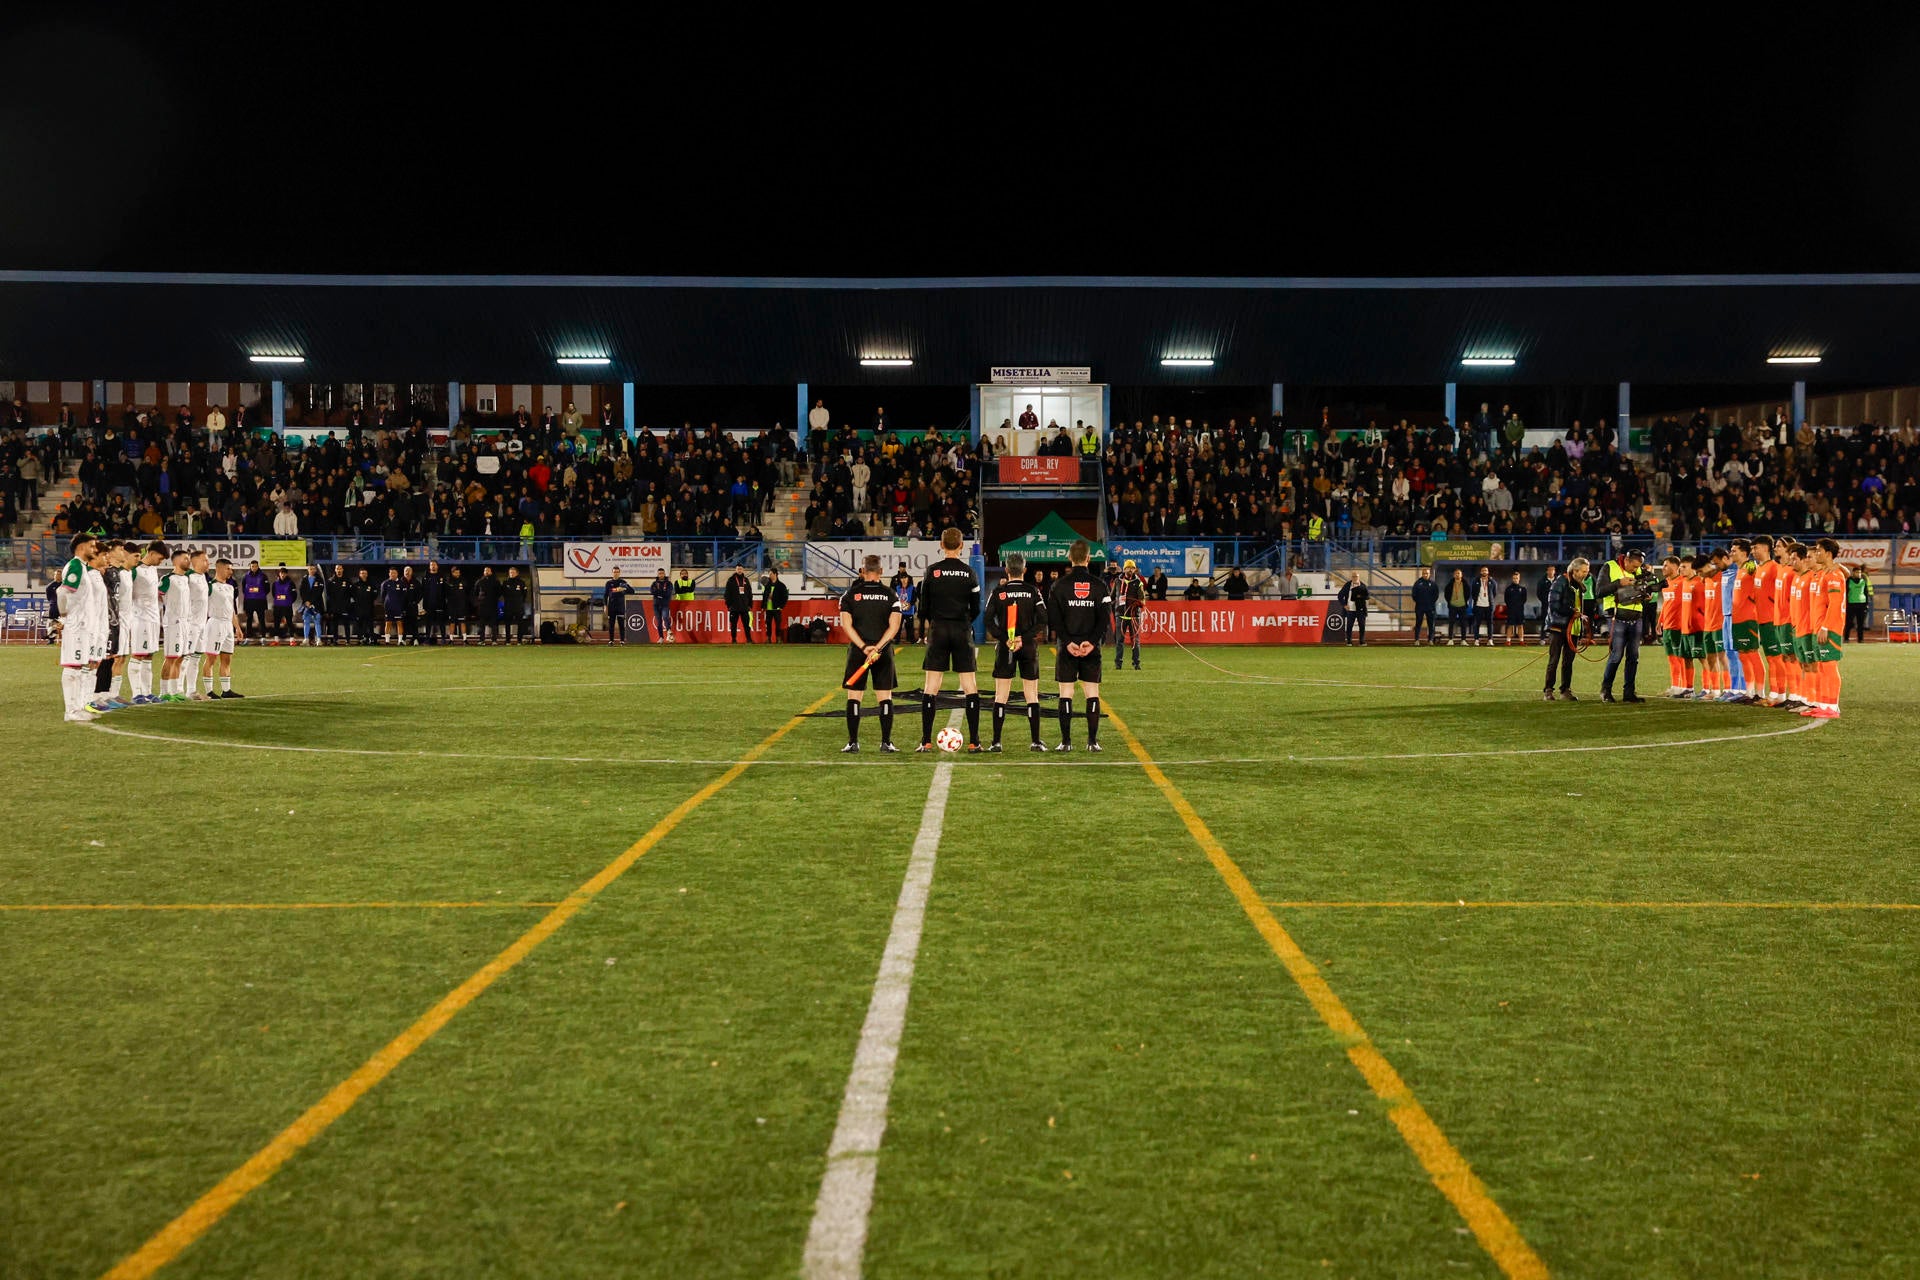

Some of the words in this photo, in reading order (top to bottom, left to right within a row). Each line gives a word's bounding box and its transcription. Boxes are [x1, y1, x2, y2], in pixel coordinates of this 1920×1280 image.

[992, 368, 1051, 376] MISETELIA
[1021, 458, 1038, 470] COPA
[1046, 458, 1058, 470] REY
[608, 546, 662, 556] VIRTON
[676, 610, 712, 632] COPA
[1140, 612, 1176, 632] COPA
[1182, 612, 1205, 632] DEL
[1211, 611, 1235, 632] REY
[1252, 616, 1319, 627] MAPFRE
[142, 641, 148, 650] 4
[175, 644, 180, 652] 8
[215, 642, 221, 651] 11
[75, 650, 81, 660] 5
